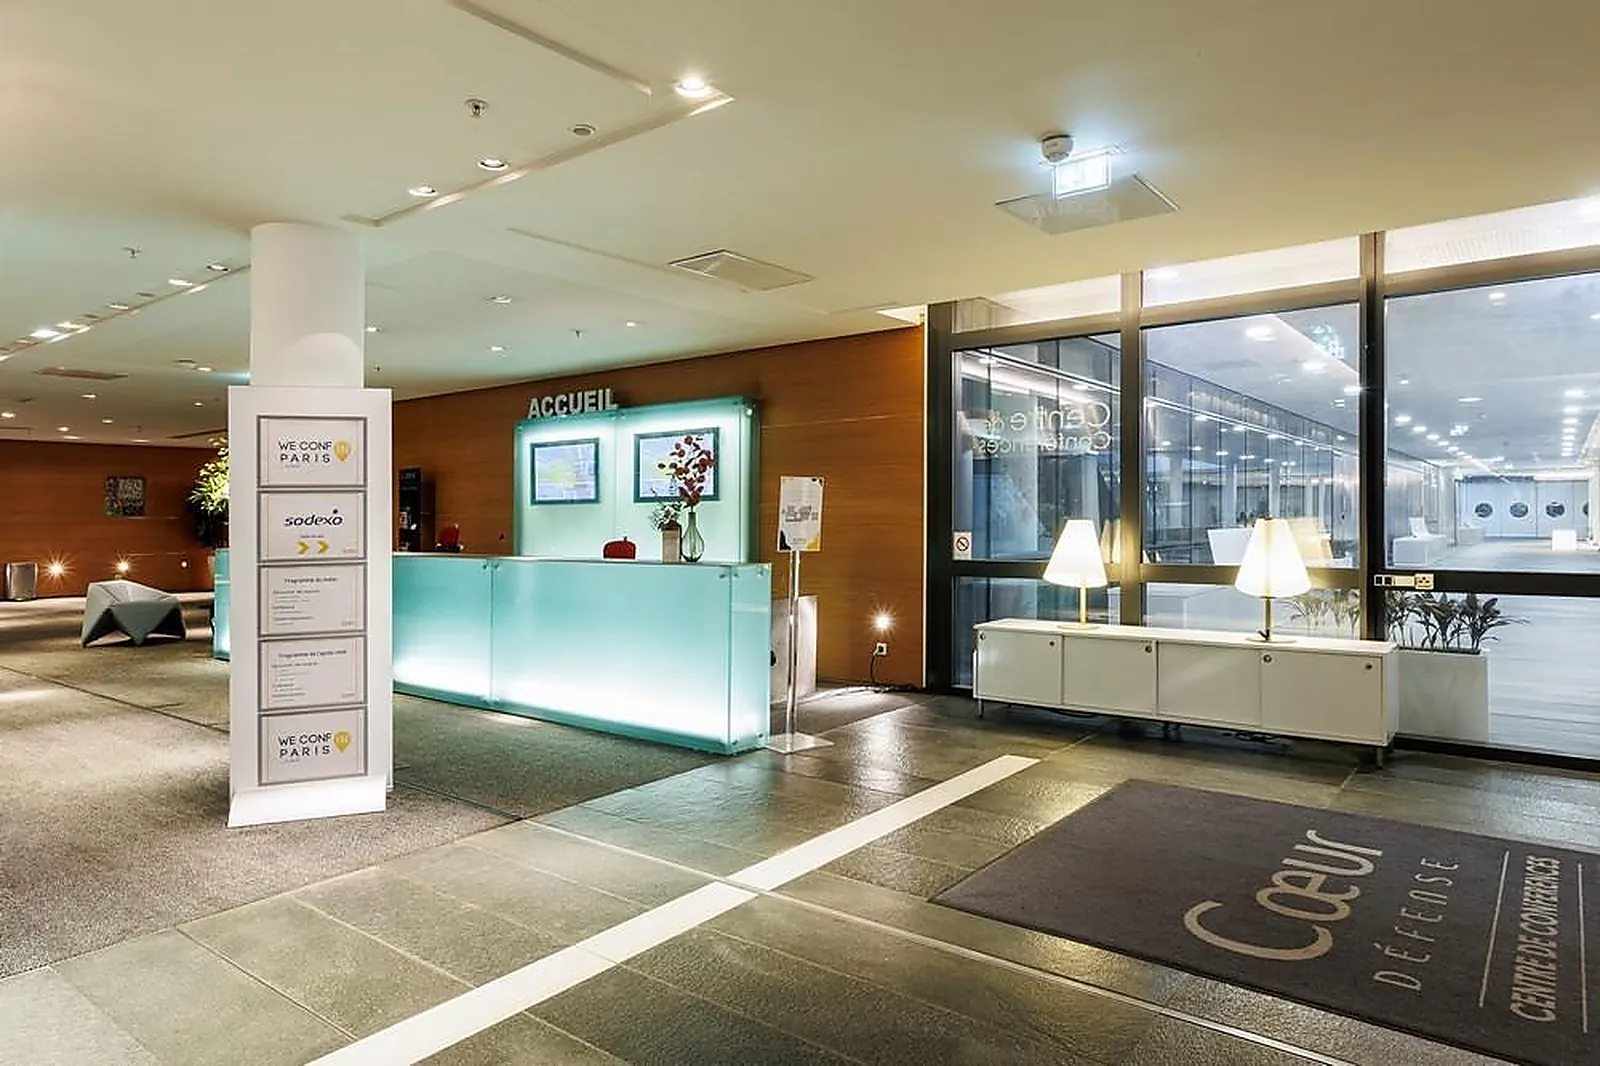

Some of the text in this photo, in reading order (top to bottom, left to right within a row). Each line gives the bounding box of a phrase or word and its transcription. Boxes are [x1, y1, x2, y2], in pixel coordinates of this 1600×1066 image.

[527, 388, 618, 419] ACCUEIL
[278, 441, 332, 451] WE CONF
[280, 453, 331, 463] PARIS
[284, 508, 343, 526] sodexo
[278, 732, 332, 746] WE CONF
[280, 745, 330, 758] PARIS
[1183, 829, 1383, 961] Cœur
[1517, 935, 1557, 958] DE
[1510, 957, 1556, 1021] CENTRE
